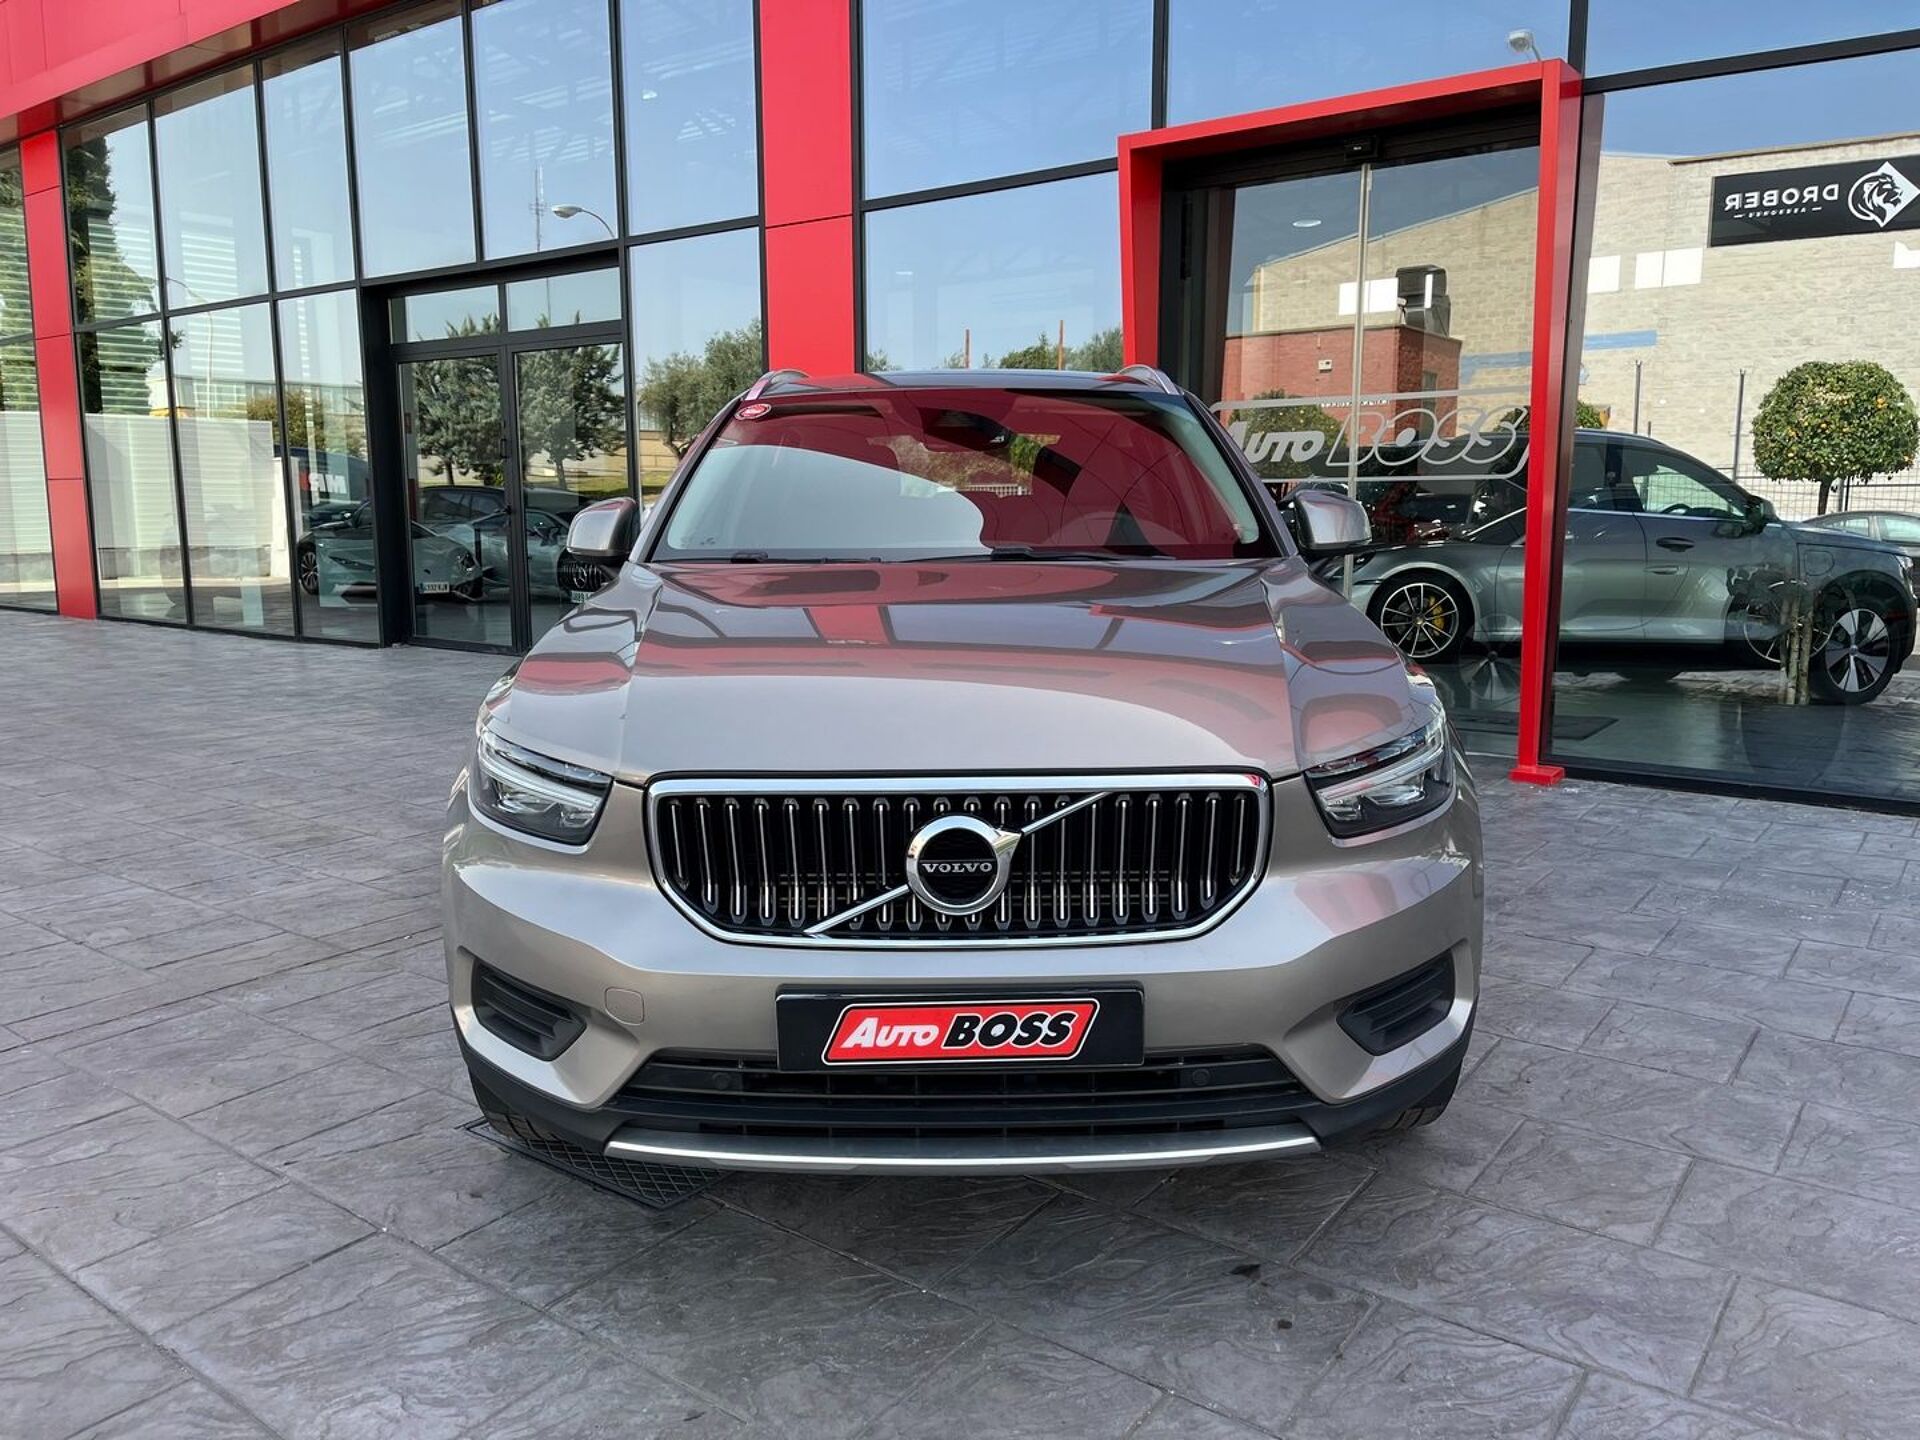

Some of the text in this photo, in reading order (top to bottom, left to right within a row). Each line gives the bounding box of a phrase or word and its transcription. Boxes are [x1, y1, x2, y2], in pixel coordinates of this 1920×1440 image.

[1325, 403, 1529, 467] BOSS
[922, 862, 993, 873] VOLVO
[940, 1011, 1080, 1050] BOSS
